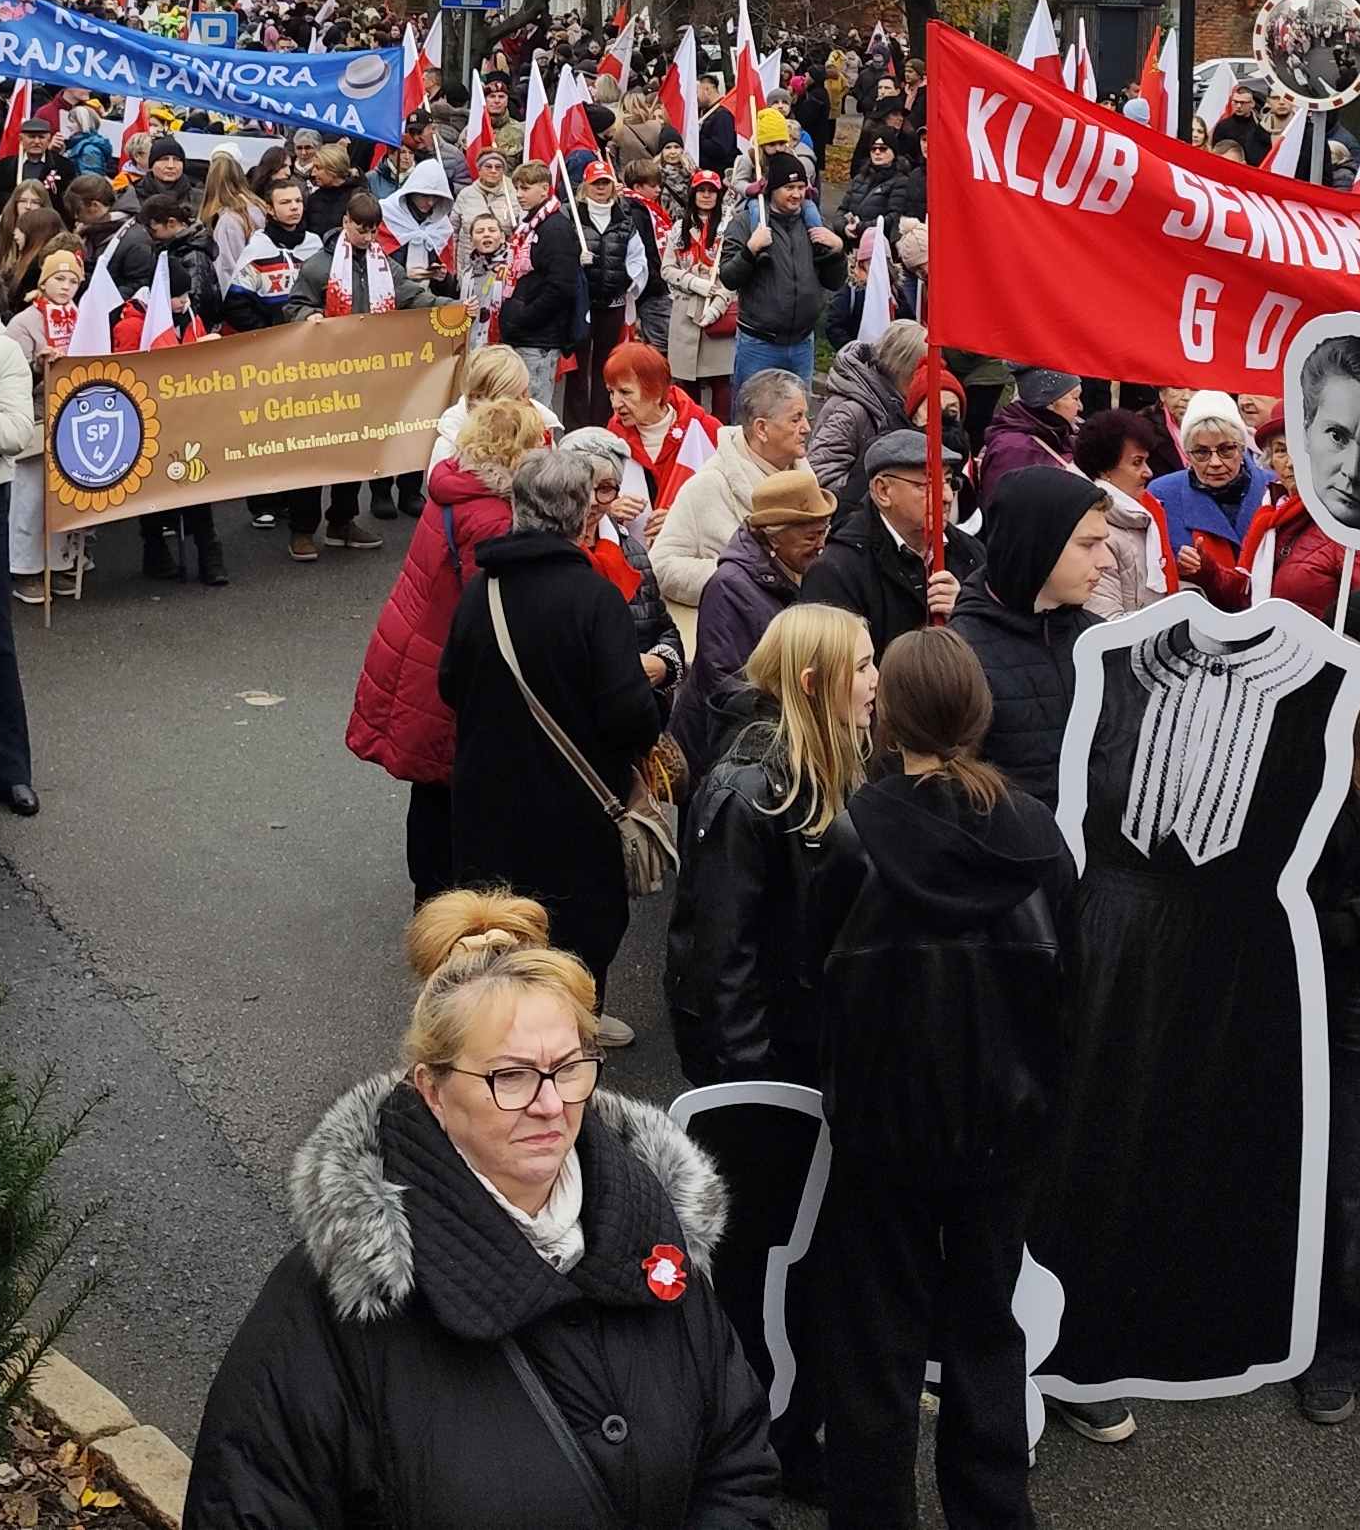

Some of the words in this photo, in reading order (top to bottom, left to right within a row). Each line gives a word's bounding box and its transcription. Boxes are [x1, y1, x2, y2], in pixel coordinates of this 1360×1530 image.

[966, 86, 1139, 215] KLUB
[158, 370, 236, 400] Szkoła
[240, 353, 385, 388] Podstawowa
[390, 349, 414, 368] nr
[419, 341, 435, 364] 4
[239, 406, 260, 425] w
[264, 390, 361, 422] Gdańsku
[86, 423, 110, 442] SP
[224, 446, 246, 461] im.
[248, 440, 285, 458] Króla
[286, 430, 359, 452] Kazimierza
[93, 446, 103, 462] 4
